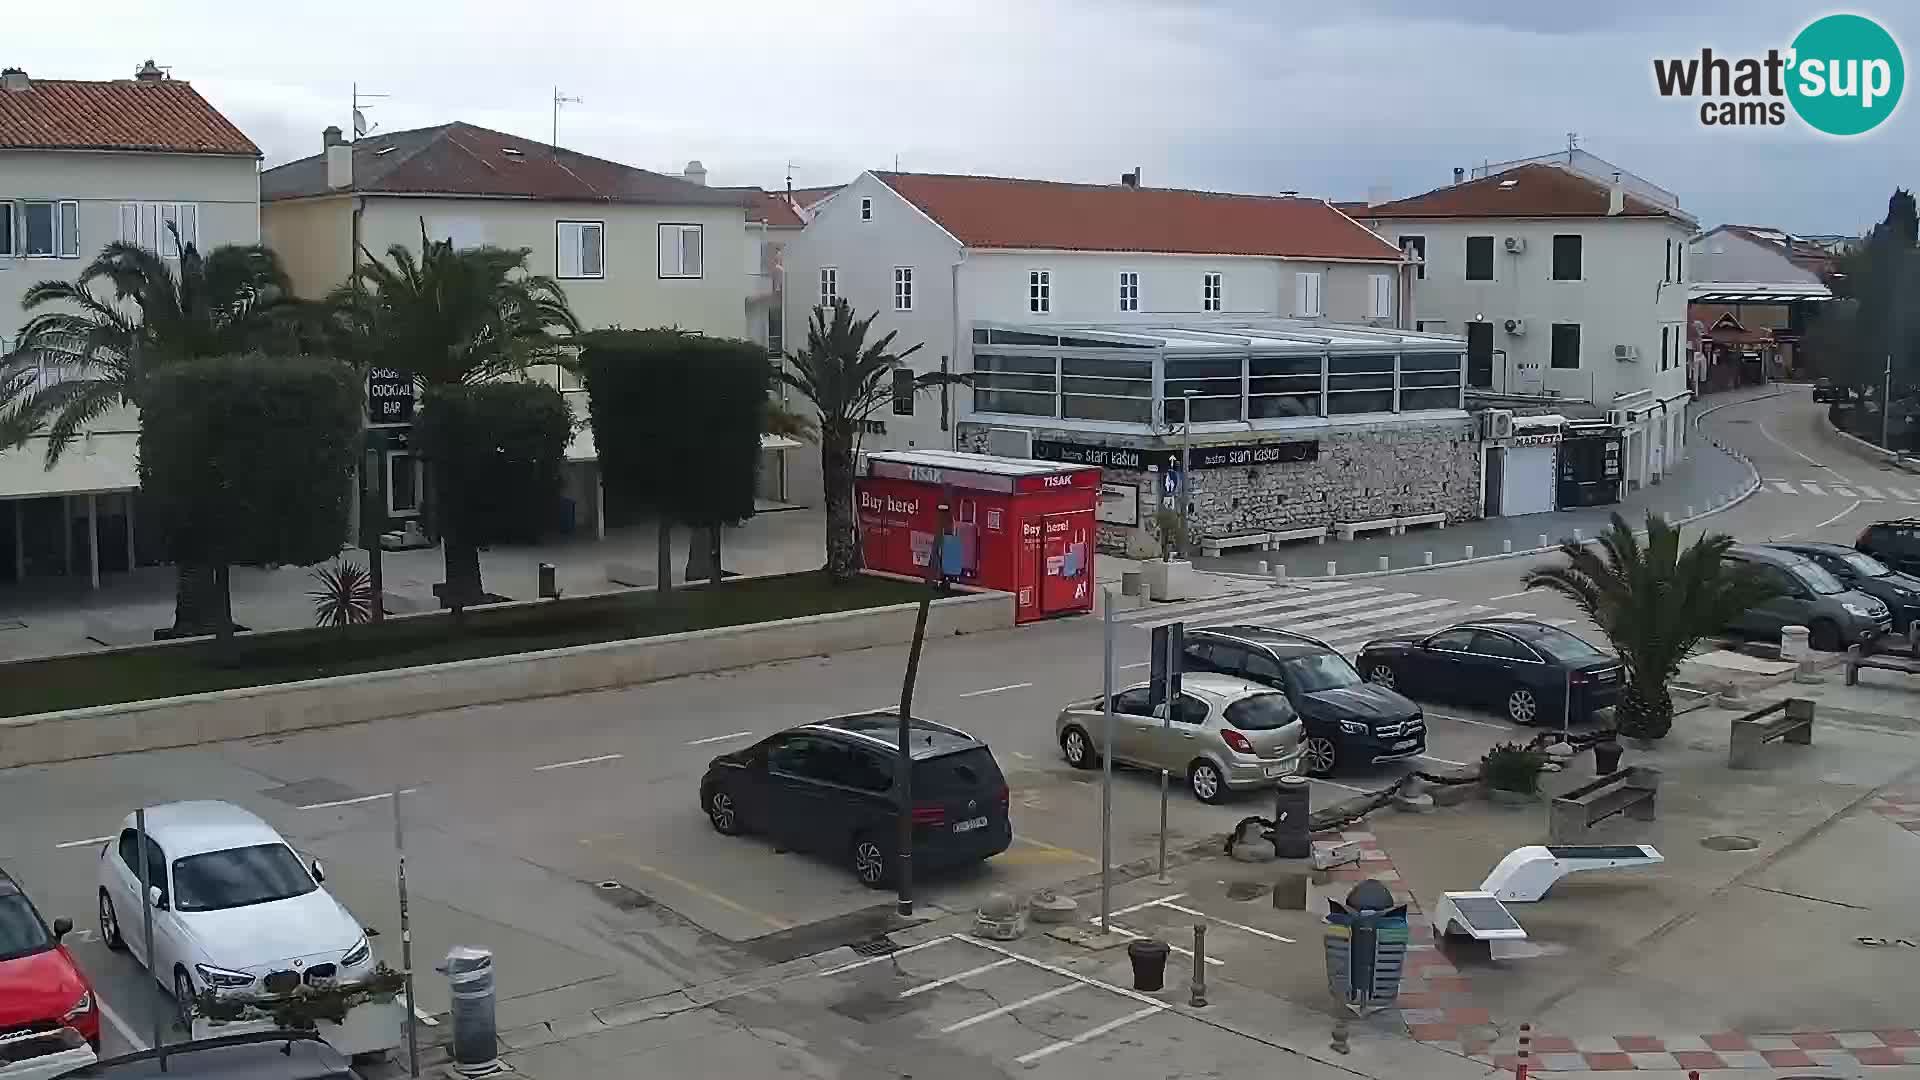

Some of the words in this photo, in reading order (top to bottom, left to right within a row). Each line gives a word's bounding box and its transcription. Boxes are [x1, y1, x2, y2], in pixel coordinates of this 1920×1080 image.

[372, 384, 411, 397] COCKTAIL
[383, 401, 401, 414] BAR
[1043, 475, 1073, 488] TISAK
[861, 491, 882, 513] Buy
[887, 495, 919, 516] here!
[1023, 522, 1041, 537] Buy
[1046, 519, 1069, 534] here!
